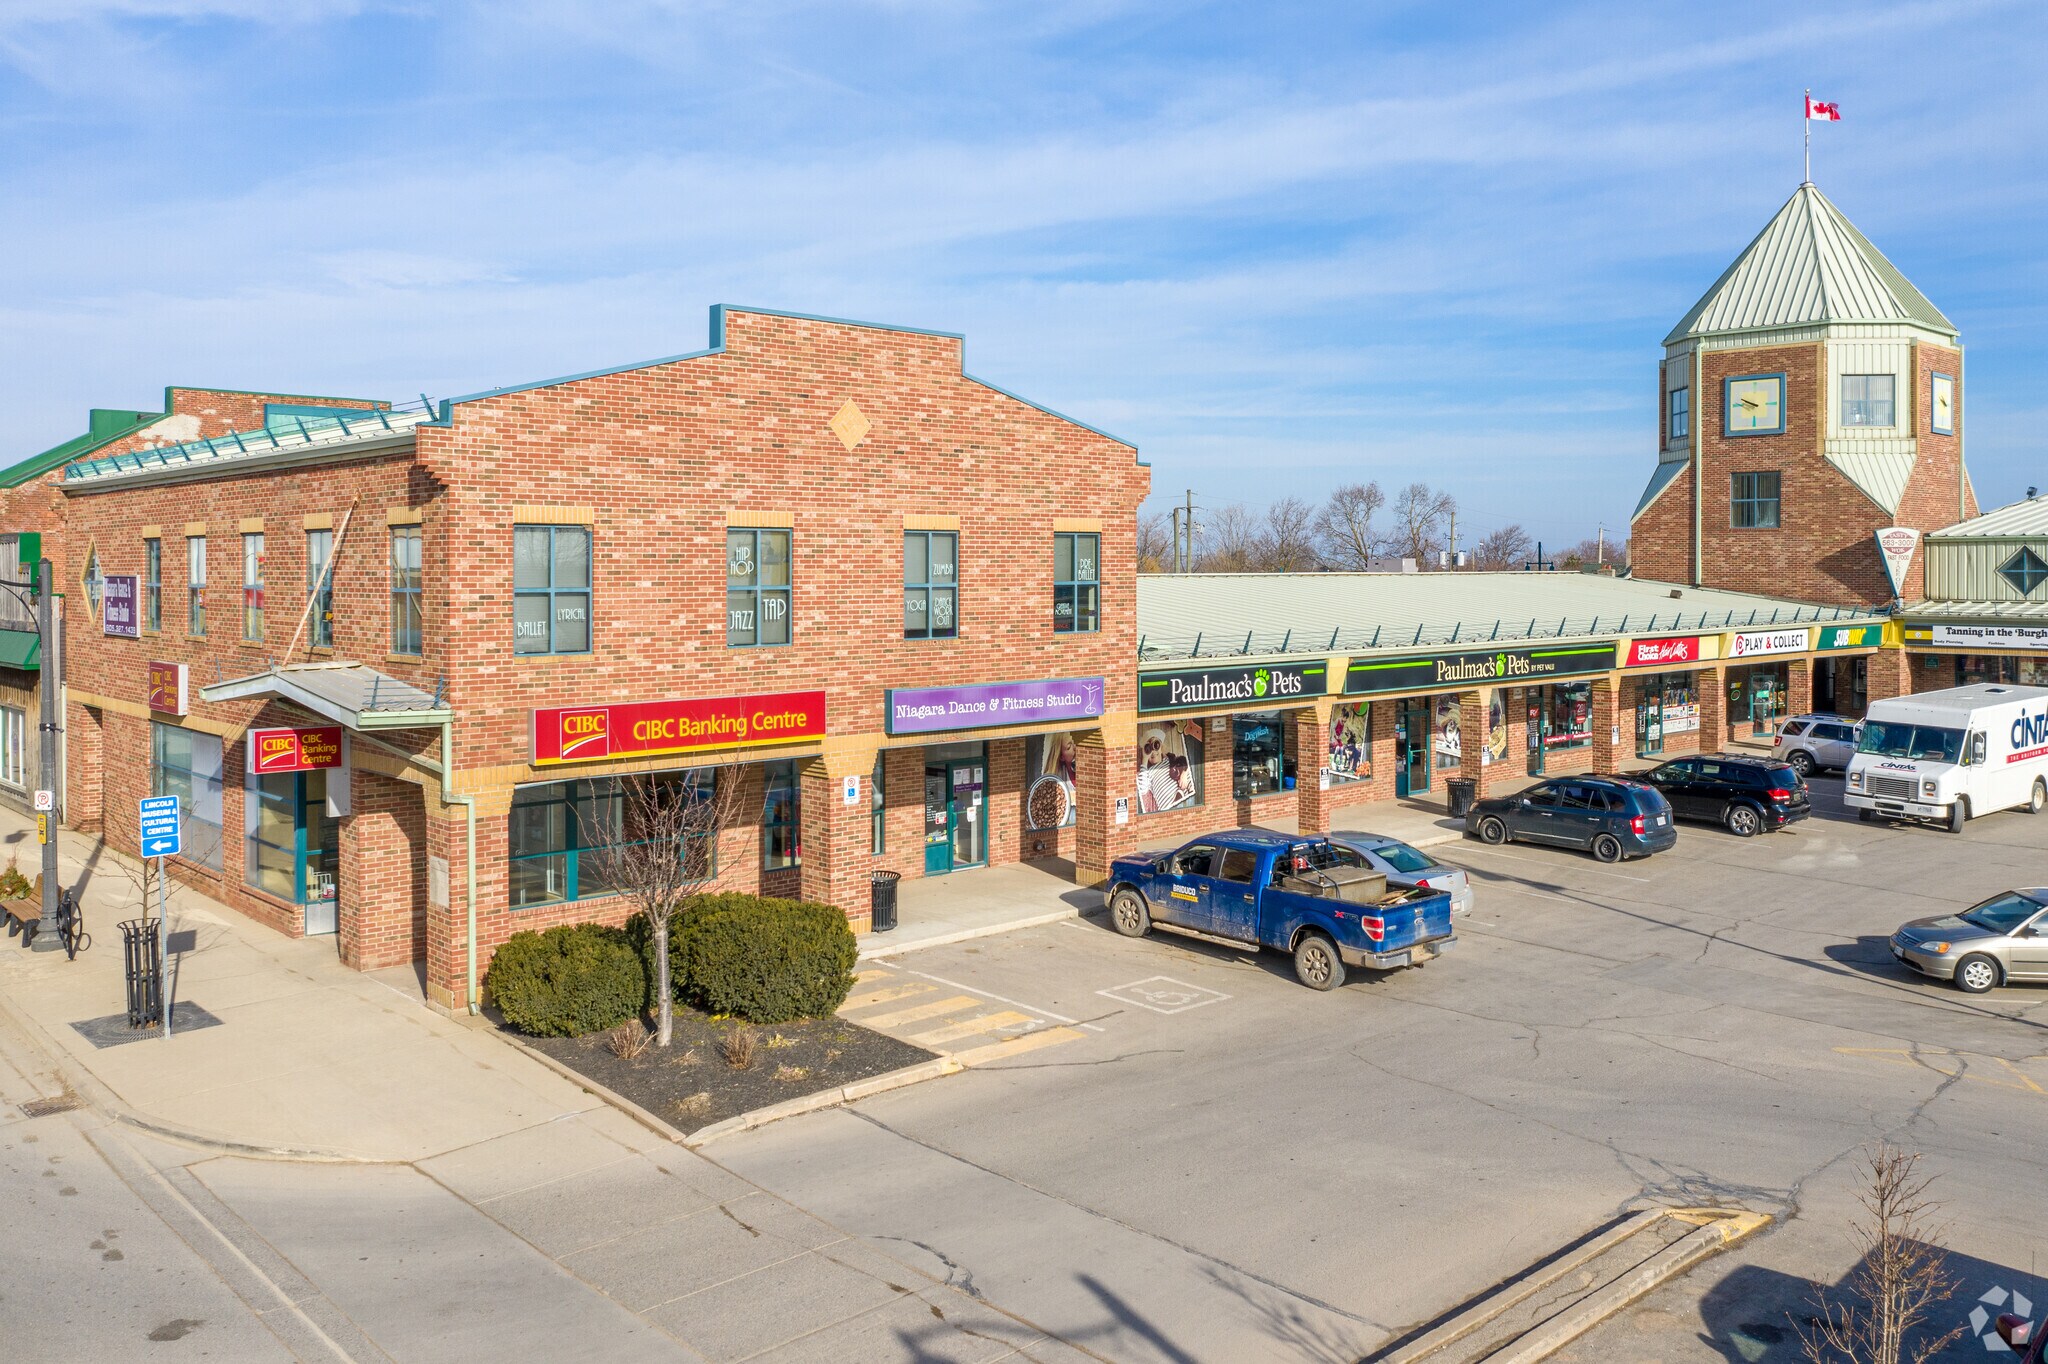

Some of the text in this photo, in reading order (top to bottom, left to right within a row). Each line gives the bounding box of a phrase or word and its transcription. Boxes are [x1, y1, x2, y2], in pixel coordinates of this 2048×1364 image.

[735, 547, 750, 561] HIP
[730, 560, 754, 576] HOP
[933, 563, 954, 575] ZUMBA
[1078, 569, 1095, 580] BALLET
[762, 598, 786, 620] TAP
[906, 599, 926, 611] YOGA
[934, 606, 954, 616] WORK
[557, 608, 586, 620] LYRICAL
[730, 610, 754, 630] JAZZ
[936, 615, 950, 626] OUT
[517, 621, 546, 636] BALLET
[1945, 626, 1984, 638] Tanning
[1985, 628, 1995, 636] in
[1996, 628, 2013, 637] the
[1744, 634, 1804, 651] PLAY & COLLECT
[1834, 627, 1867, 647] SUBWAY
[1638, 644, 1660, 652] First
[1638, 652, 1659, 660] Choice
[1436, 656, 1495, 682] Paulmac's
[1507, 654, 1530, 676] Pets
[1170, 670, 1302, 704] Paulmac's Pets
[896, 693, 1082, 719] Niagara Dance & Fitness Studio
[563, 714, 606, 734] CIBC
[632, 711, 808, 741] CIBC Banking Centre
[262, 738, 295, 752] CIBC
[302, 734, 322, 744] CIBC
[302, 744, 337, 754] Banking
[302, 755, 332, 764] Centre
[144, 800, 174, 809] LINCOLN
[142, 808, 171, 818] MUSEUM
[142, 816, 176, 826] CULTURAL
[146, 826, 174, 836] CENTRE
[1172, 884, 1196, 896] BRIDUCO
